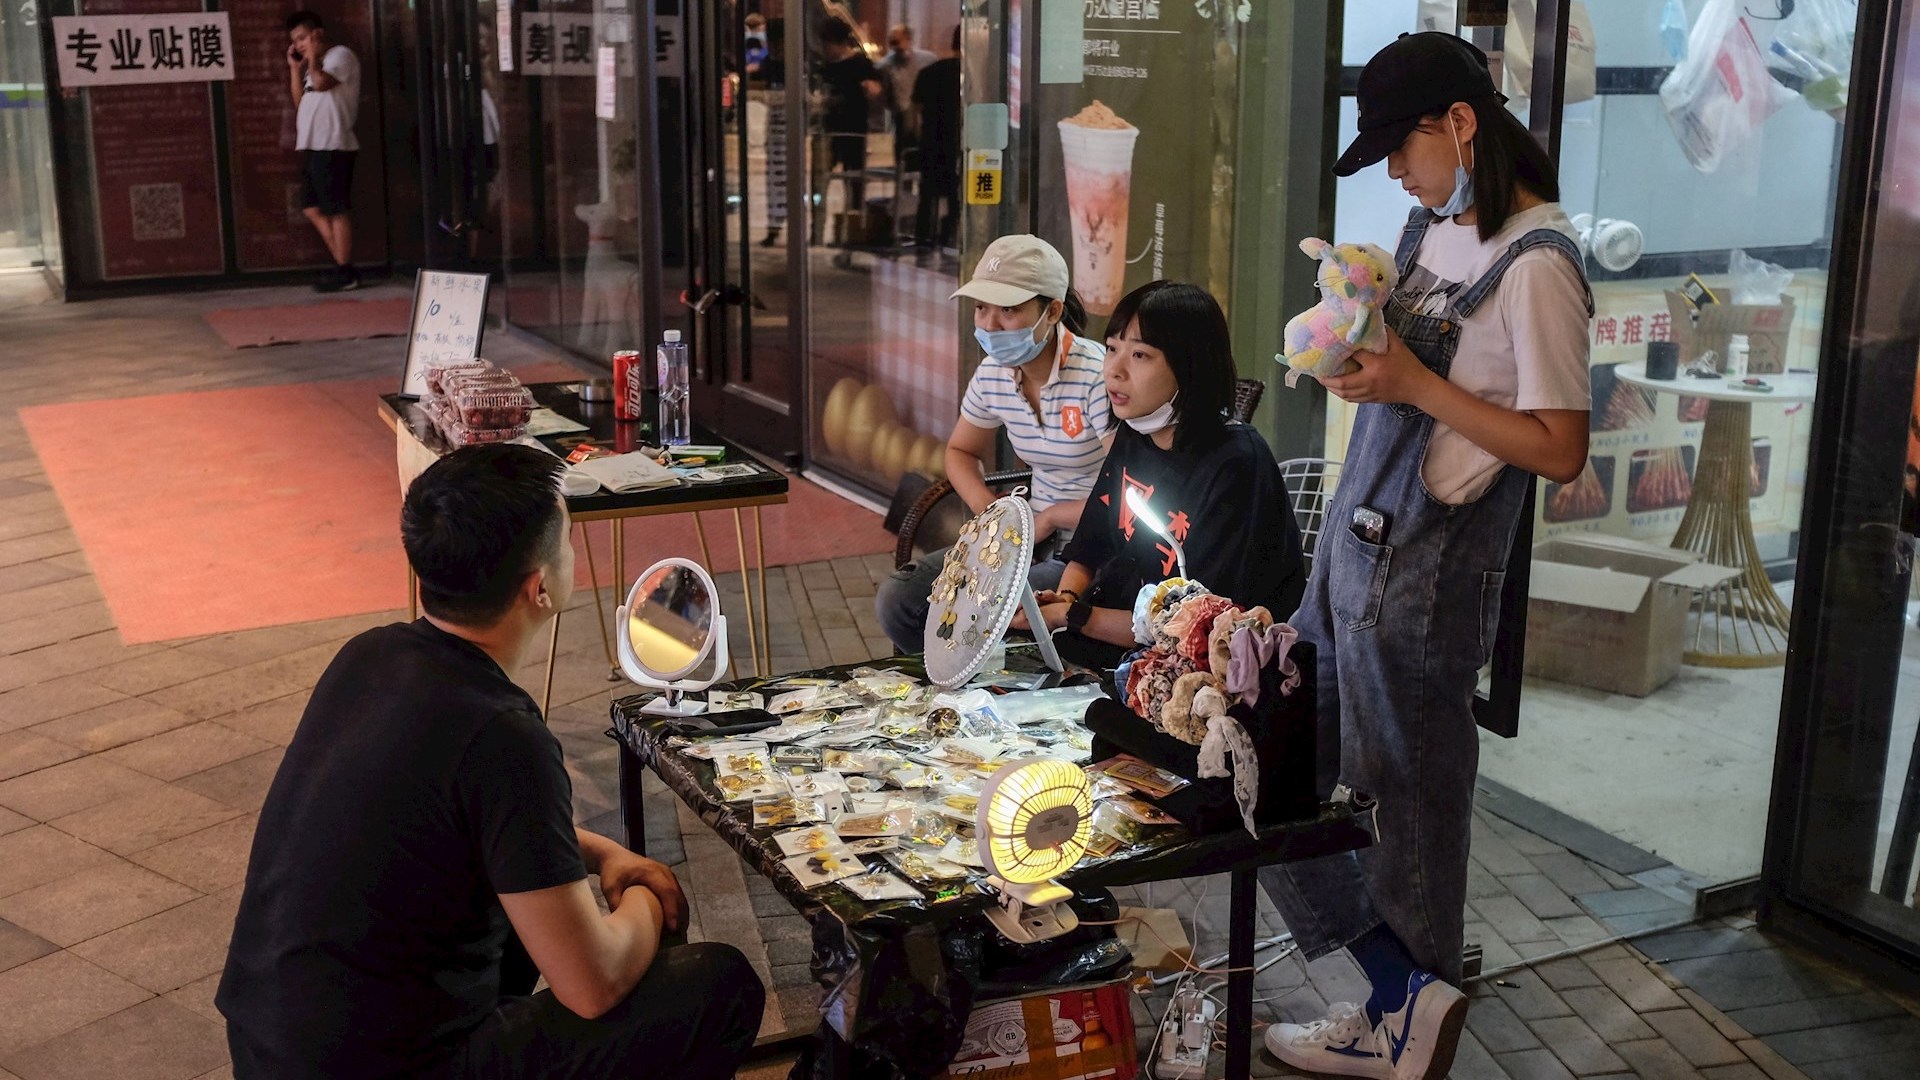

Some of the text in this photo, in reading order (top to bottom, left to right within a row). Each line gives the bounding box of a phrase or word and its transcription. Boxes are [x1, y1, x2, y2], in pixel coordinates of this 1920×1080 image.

[66, 25, 226, 73] 专业贴膜
[976, 172, 993, 192] 推
